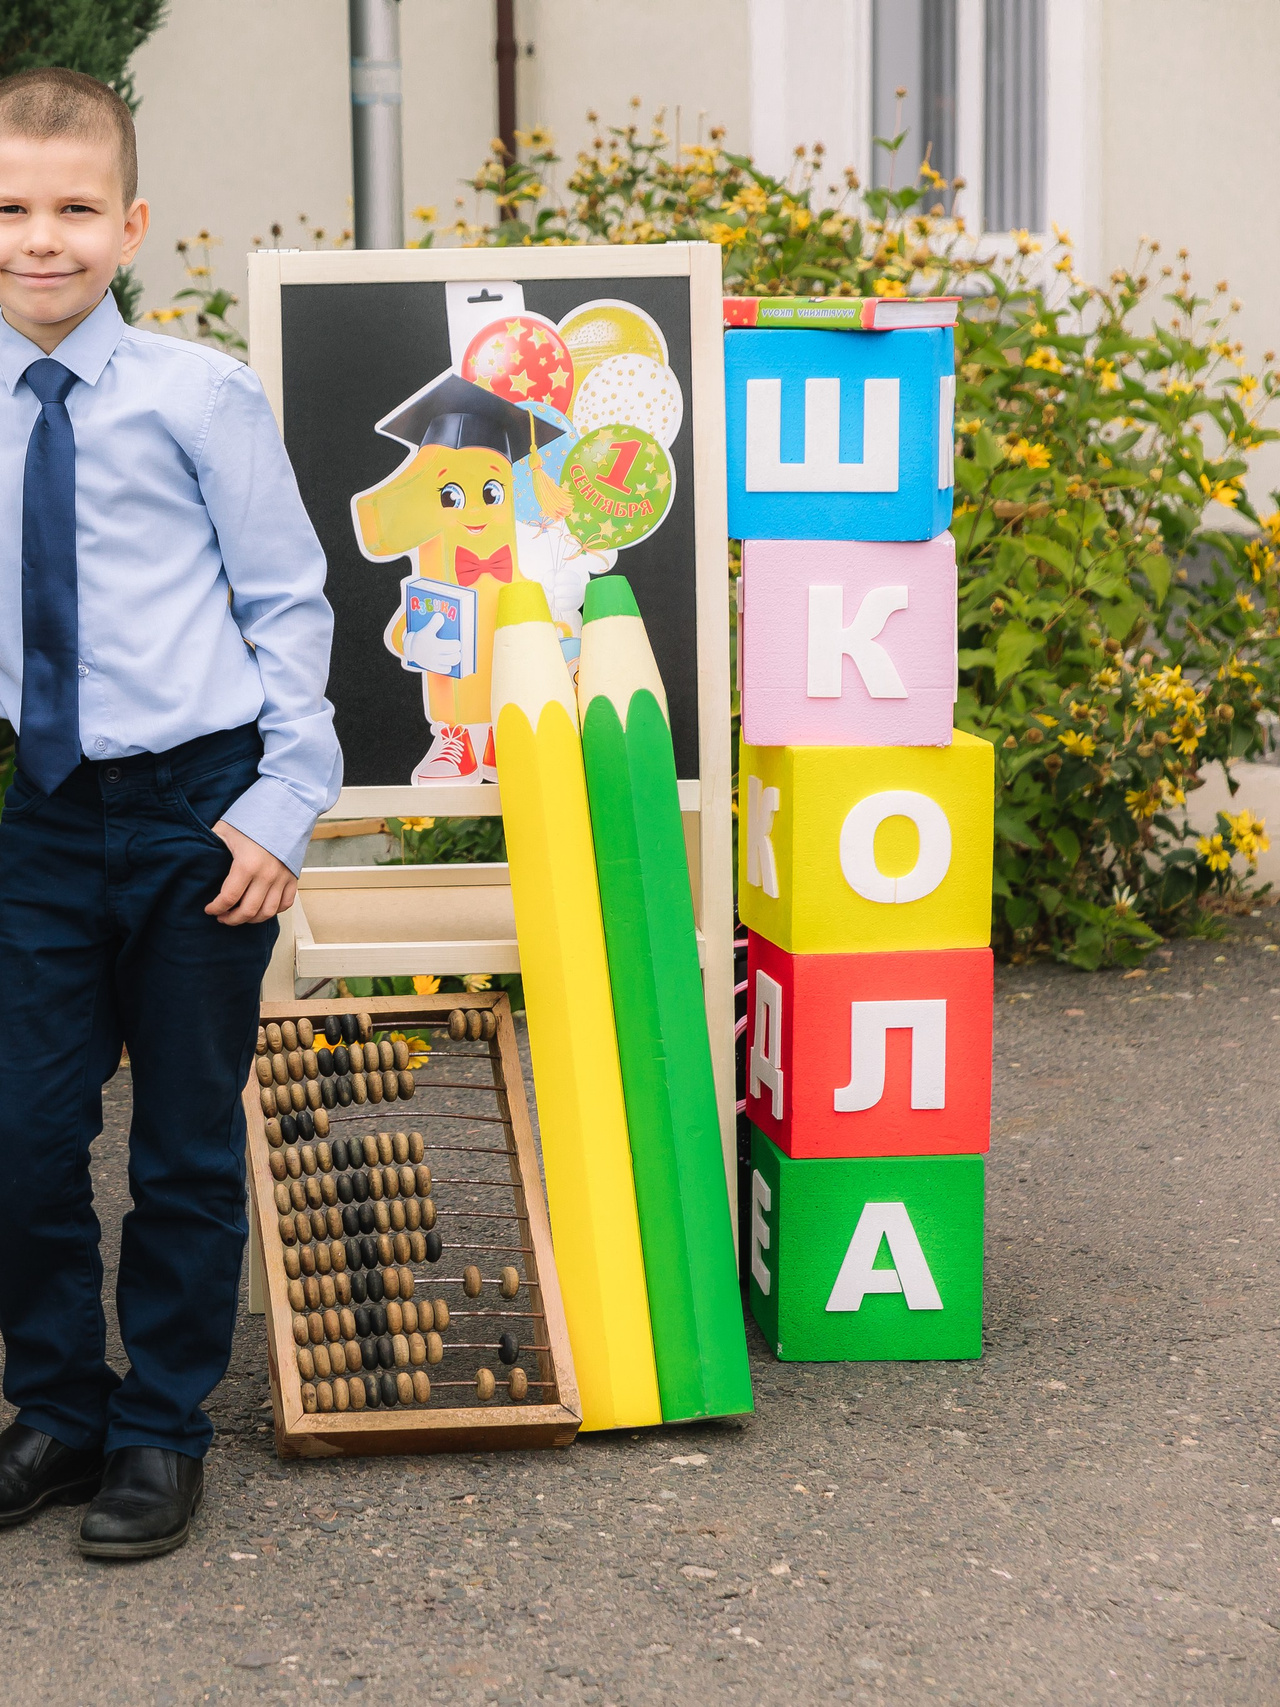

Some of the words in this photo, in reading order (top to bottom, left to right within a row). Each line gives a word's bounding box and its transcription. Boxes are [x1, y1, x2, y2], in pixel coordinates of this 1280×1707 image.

[761, 308, 794, 318] ШКОЛА
[797, 308, 856, 319] МАЛЫШКИНА
[570, 464, 654, 518] СЕНТЯБРЯ
[595, 439, 642, 495] 1
[745, 377, 900, 493] Ш
[410, 596, 457, 621] АЗБУКА
[807, 584, 908, 699] К
[839, 790, 952, 904] О
[750, 969, 783, 1120] Д
[834, 999, 947, 1113] Л
[751, 1168, 771, 1297] Е
[825, 1202, 944, 1312] А
